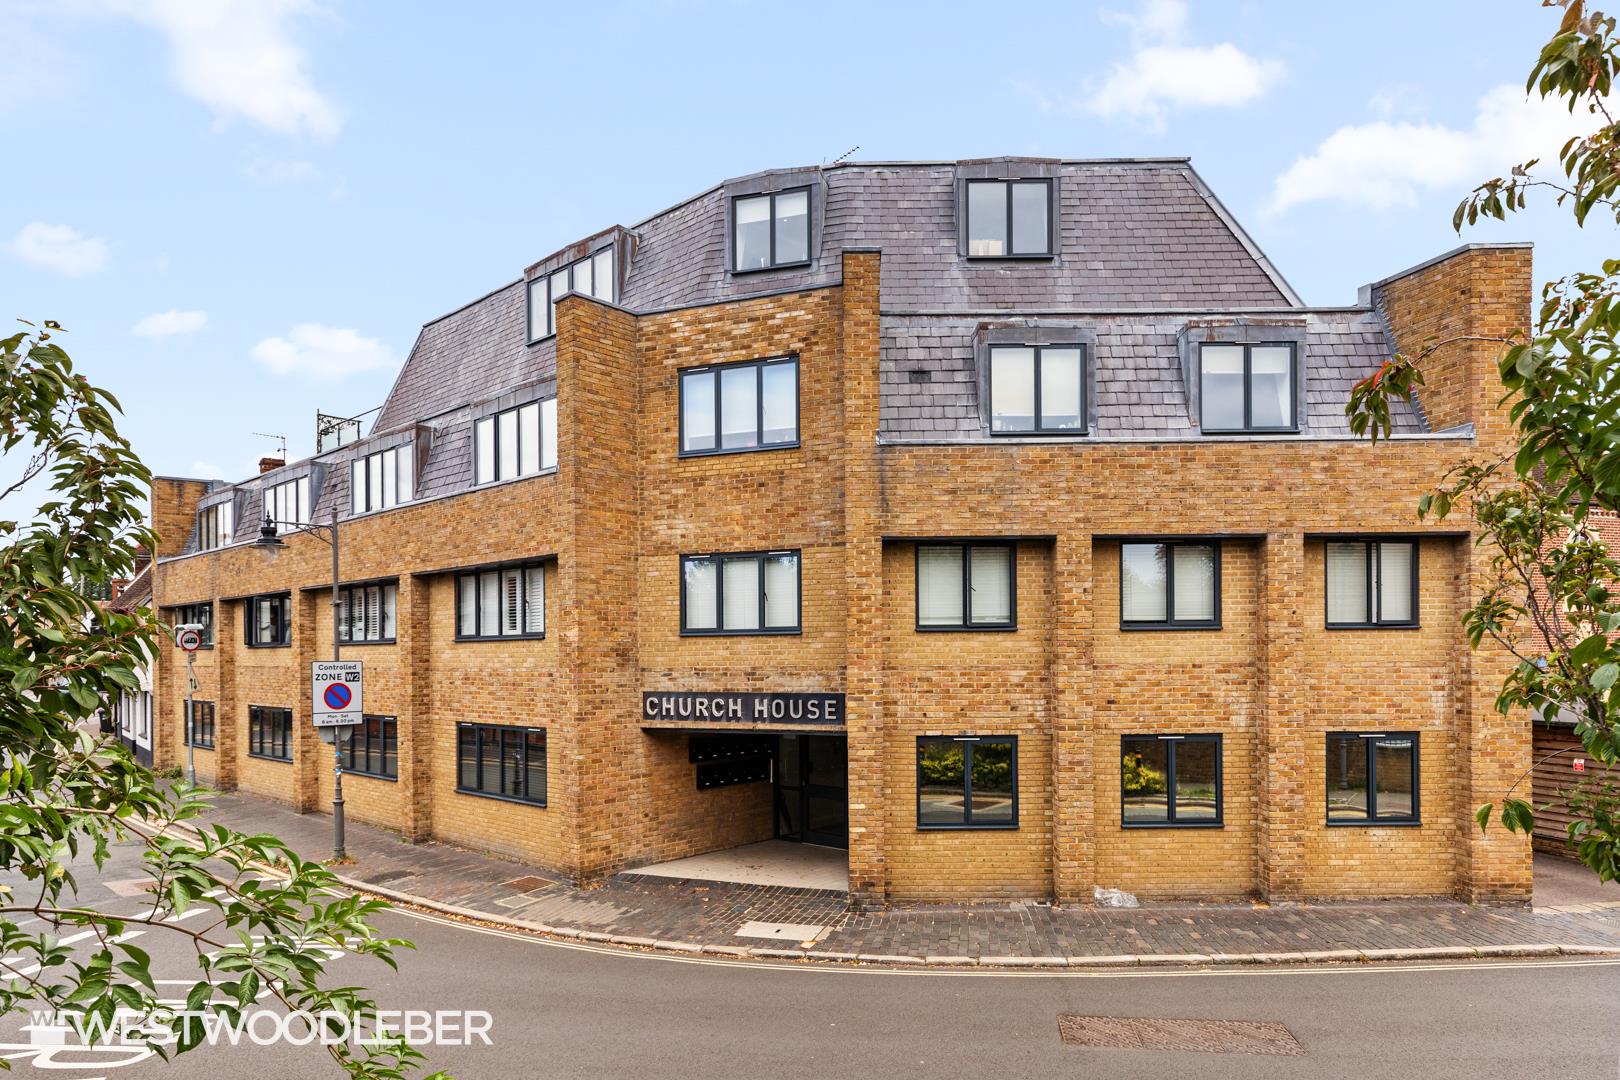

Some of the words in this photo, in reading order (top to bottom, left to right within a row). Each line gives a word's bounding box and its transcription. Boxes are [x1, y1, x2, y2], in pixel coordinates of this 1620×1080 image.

[315, 673, 342, 681] ZONE
[345, 672, 360, 682] W2
[646, 697, 742, 718] CHURCH
[754, 698, 837, 720] HOUSE
